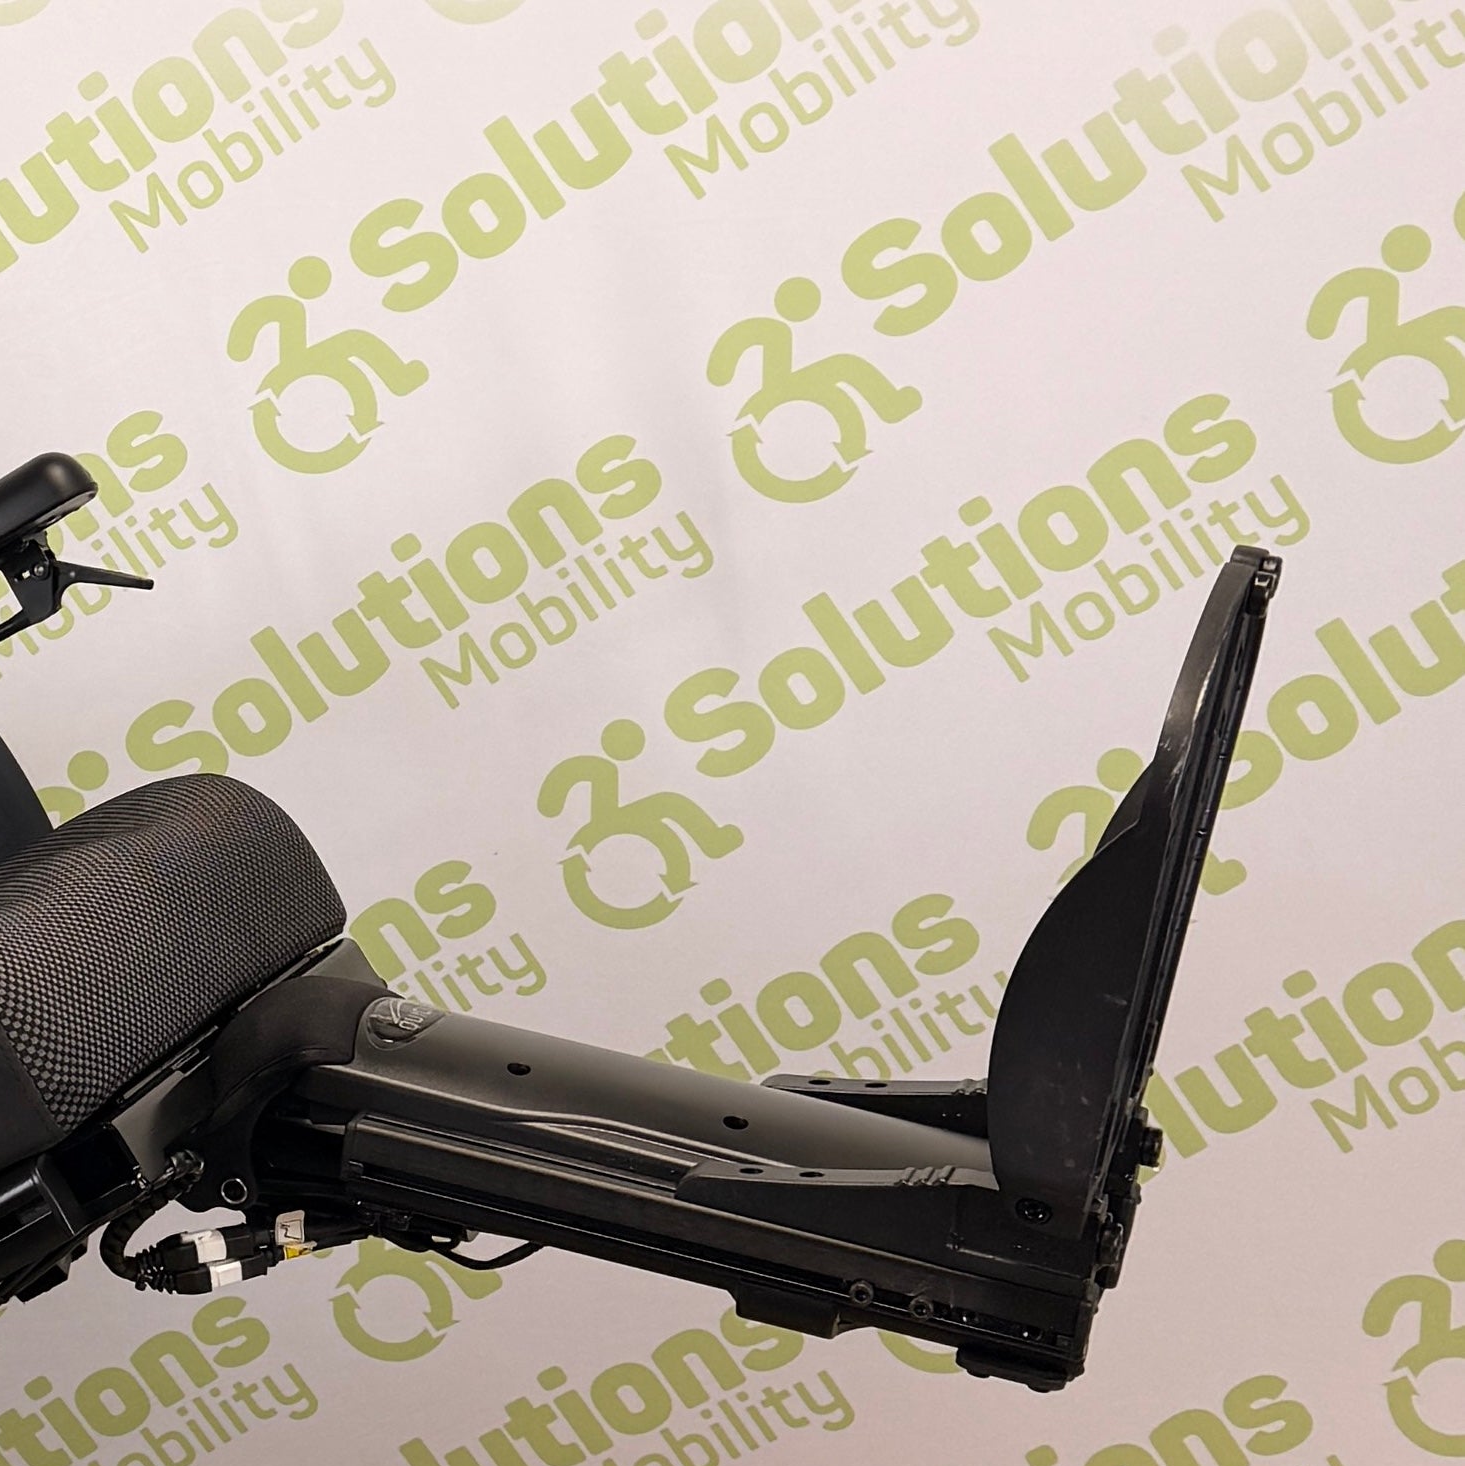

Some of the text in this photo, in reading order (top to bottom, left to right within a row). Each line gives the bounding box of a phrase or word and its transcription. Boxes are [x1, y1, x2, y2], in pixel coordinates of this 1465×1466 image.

[107, 37, 397, 254] Mobility
[664, 0, 980, 200] Mobility
[122, 433, 664, 779] Solutions
[418, 510, 716, 711] Mobility
[662, 392, 1259, 781] Solutions
[986, 473, 1312, 684] Mobility
[644, 892, 982, 1082] tions
